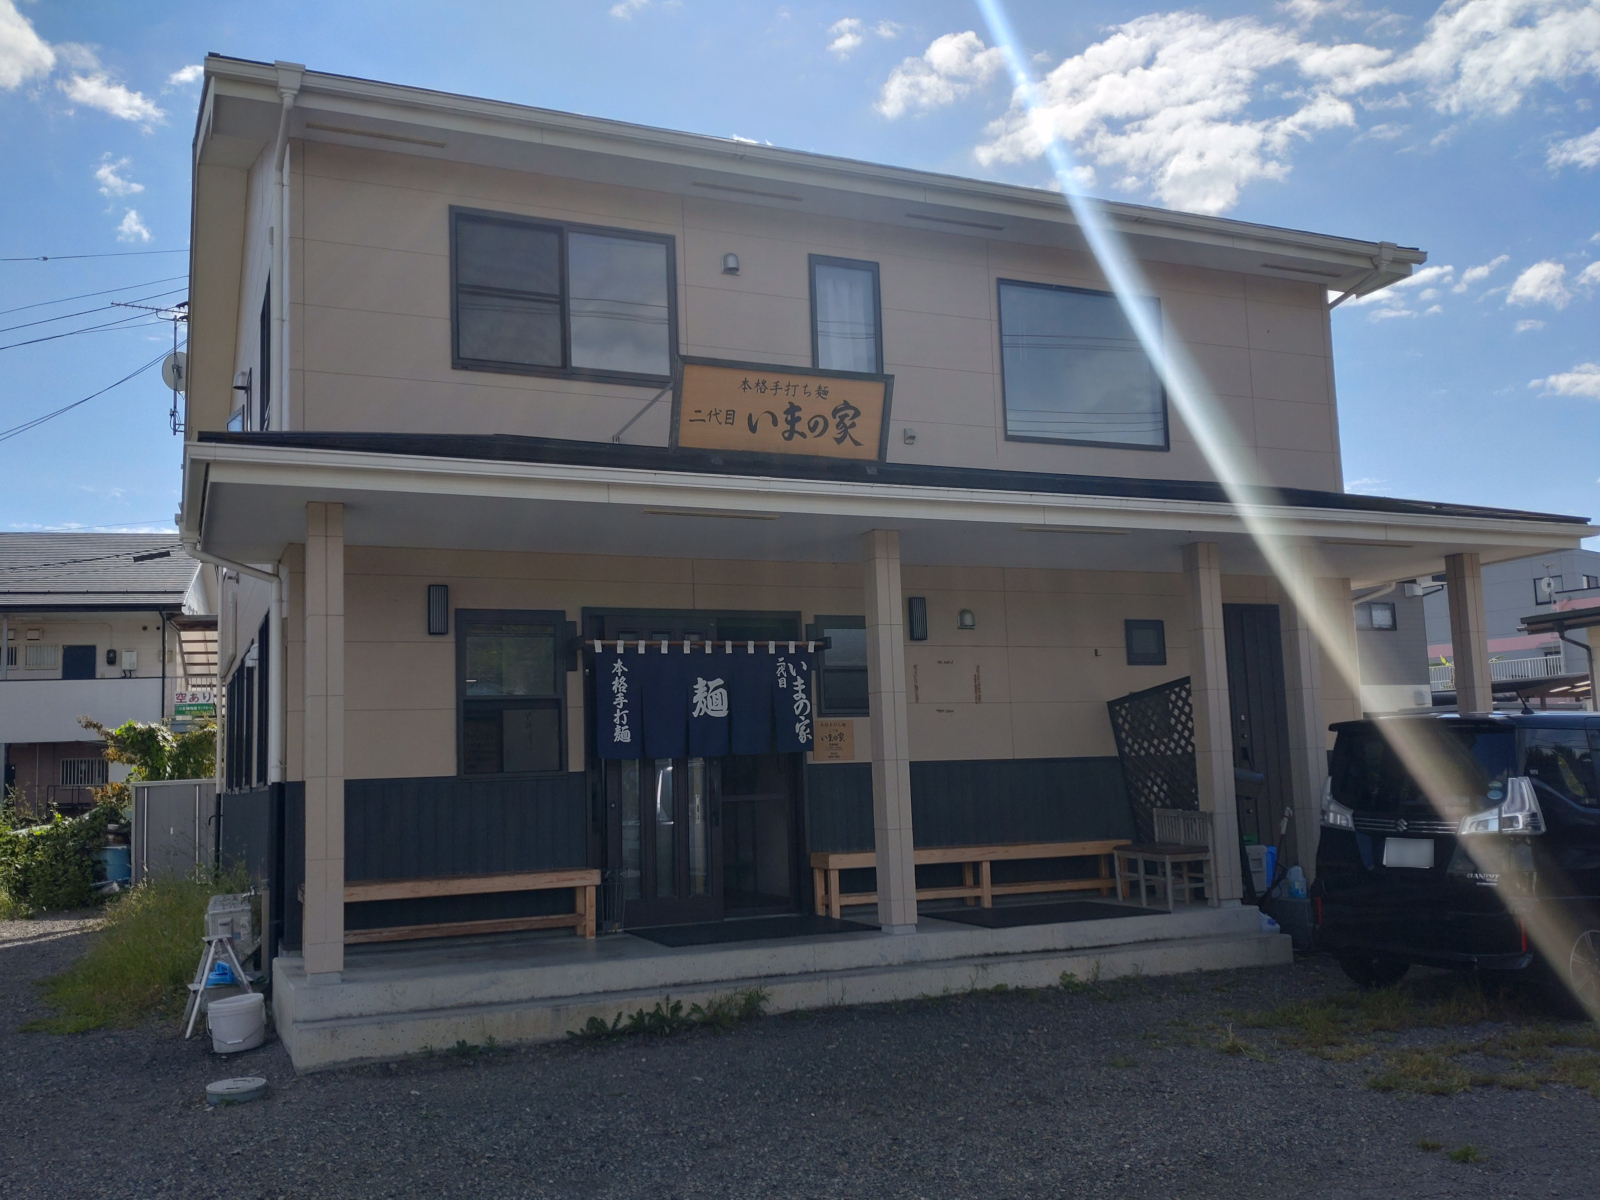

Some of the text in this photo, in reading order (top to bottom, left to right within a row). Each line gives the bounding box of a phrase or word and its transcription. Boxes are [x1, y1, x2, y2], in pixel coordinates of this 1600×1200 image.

[738, 377, 829, 399] 本格手打ち麺
[688, 400, 864, 446] 二代目 いまの家
[776, 656, 787, 689] 二代目
[175, 692, 211, 703] 空あり
[611, 658, 632, 743] 本格手打麺
[692, 677, 729, 718] 麺
[788, 661, 813, 744] いまの家
